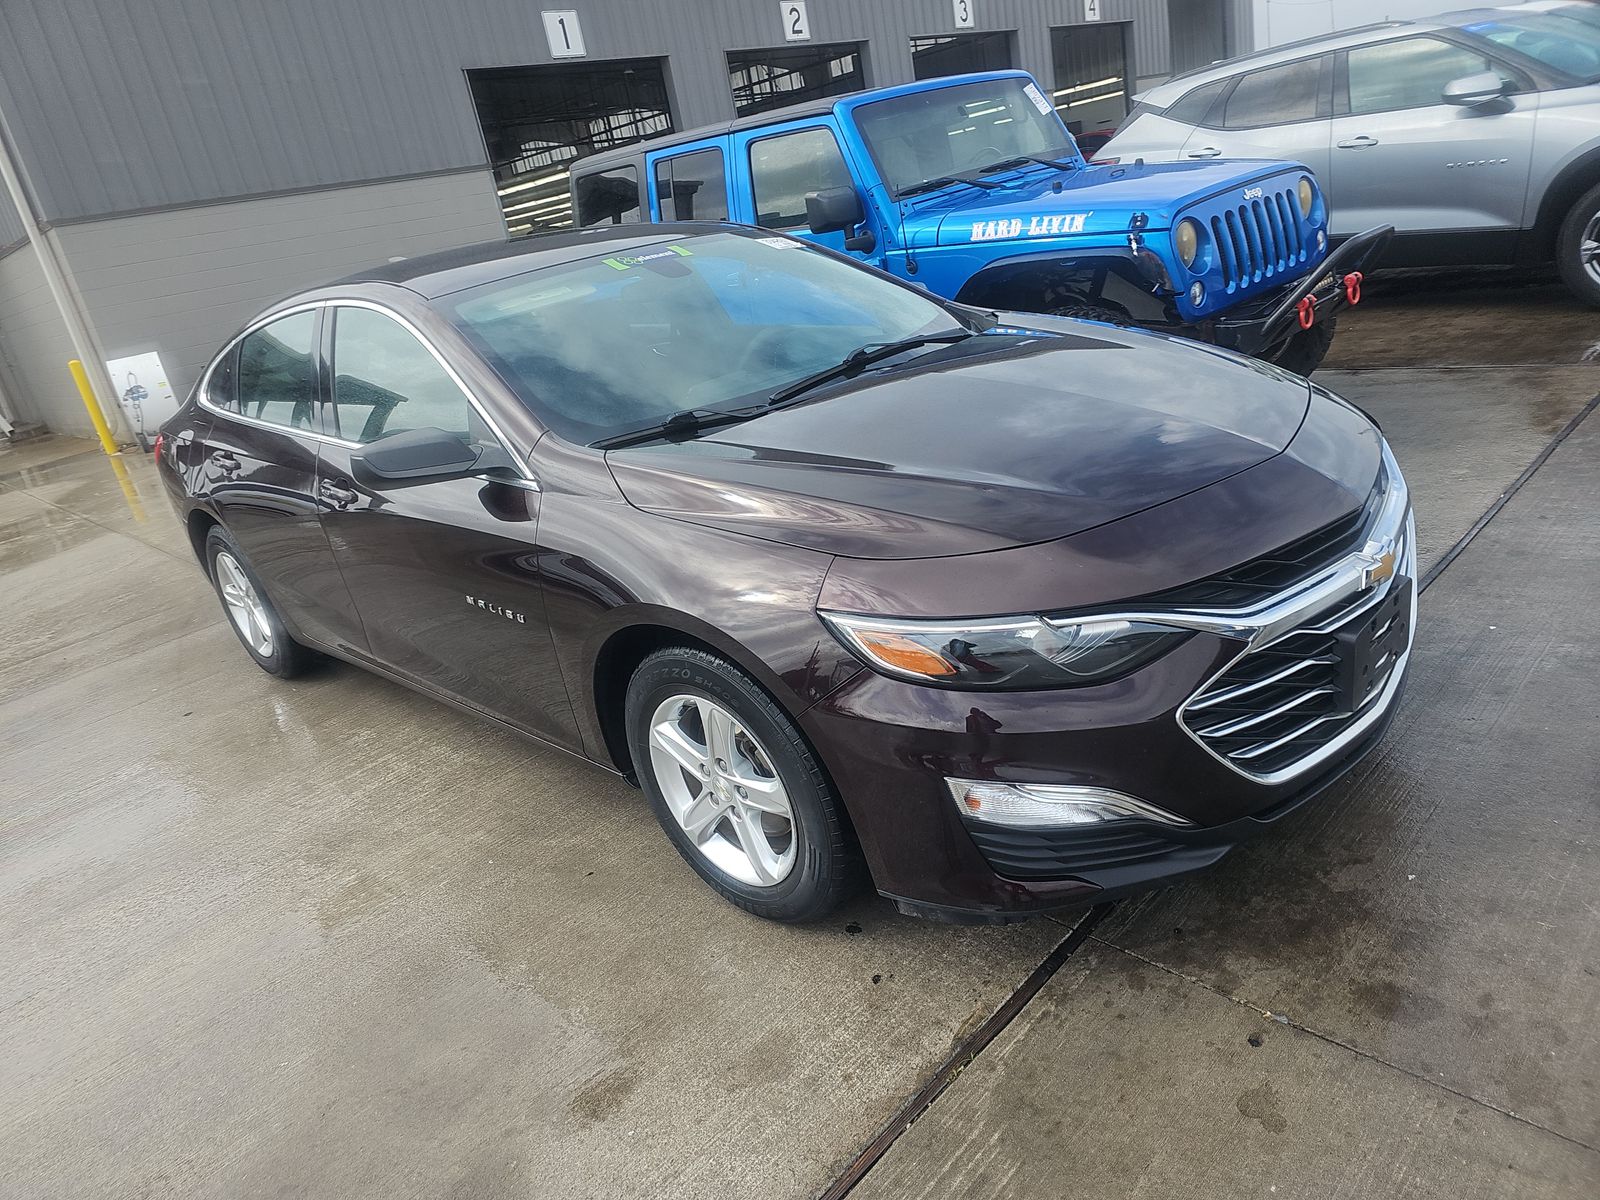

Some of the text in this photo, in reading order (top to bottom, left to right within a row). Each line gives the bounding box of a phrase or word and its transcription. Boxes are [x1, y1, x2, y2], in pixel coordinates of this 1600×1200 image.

[959, 0, 969, 23] 3
[1088, 0, 1097, 17] 4
[788, 7, 804, 35] 2
[557, 17, 571, 50] 1
[1243, 187, 1263, 200] Jeep
[970, 218, 1022, 242] HARD
[465, 595, 525, 624] MALIBU
